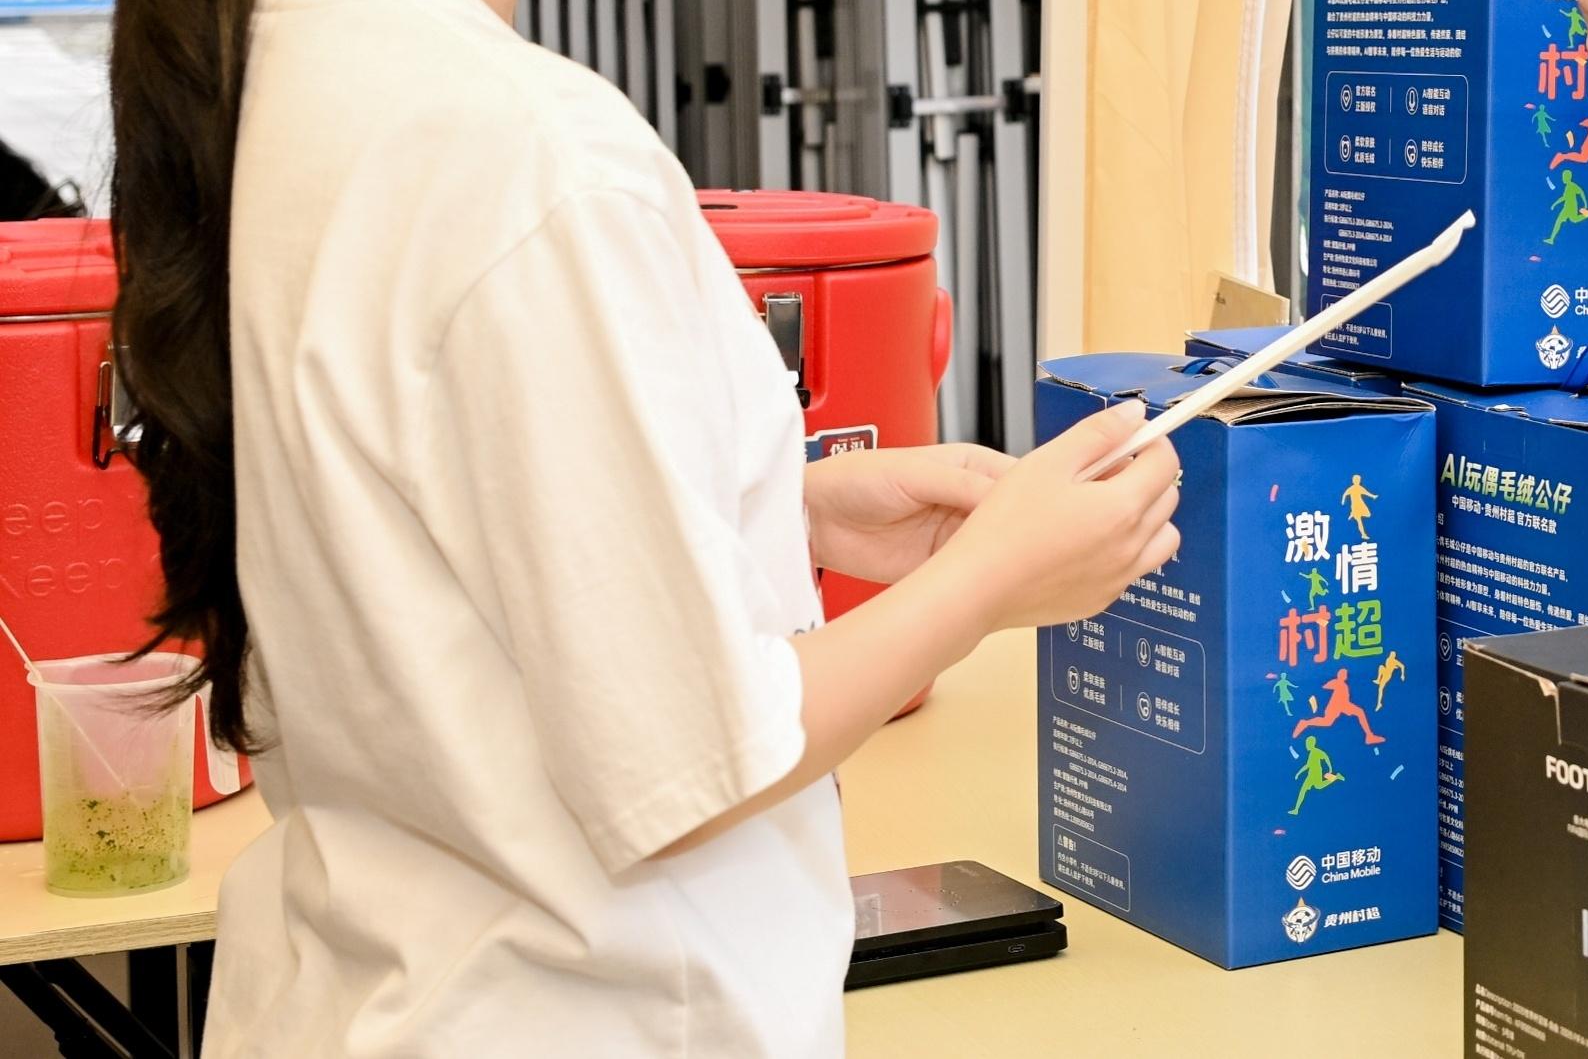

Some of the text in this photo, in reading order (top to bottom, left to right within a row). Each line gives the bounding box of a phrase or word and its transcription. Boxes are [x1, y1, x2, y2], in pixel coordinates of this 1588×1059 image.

[1439, 452, 1574, 516] AI玩偶毛绒公仔
[1516, 511, 1558, 535] 官方联名款
[1285, 510, 1379, 595] 激情
[1279, 599, 1384, 667] 村超
[1321, 845, 1381, 871] 中国移动
[1321, 864, 1381, 884] China Mobile
[1323, 906, 1381, 928] 贵州村超
